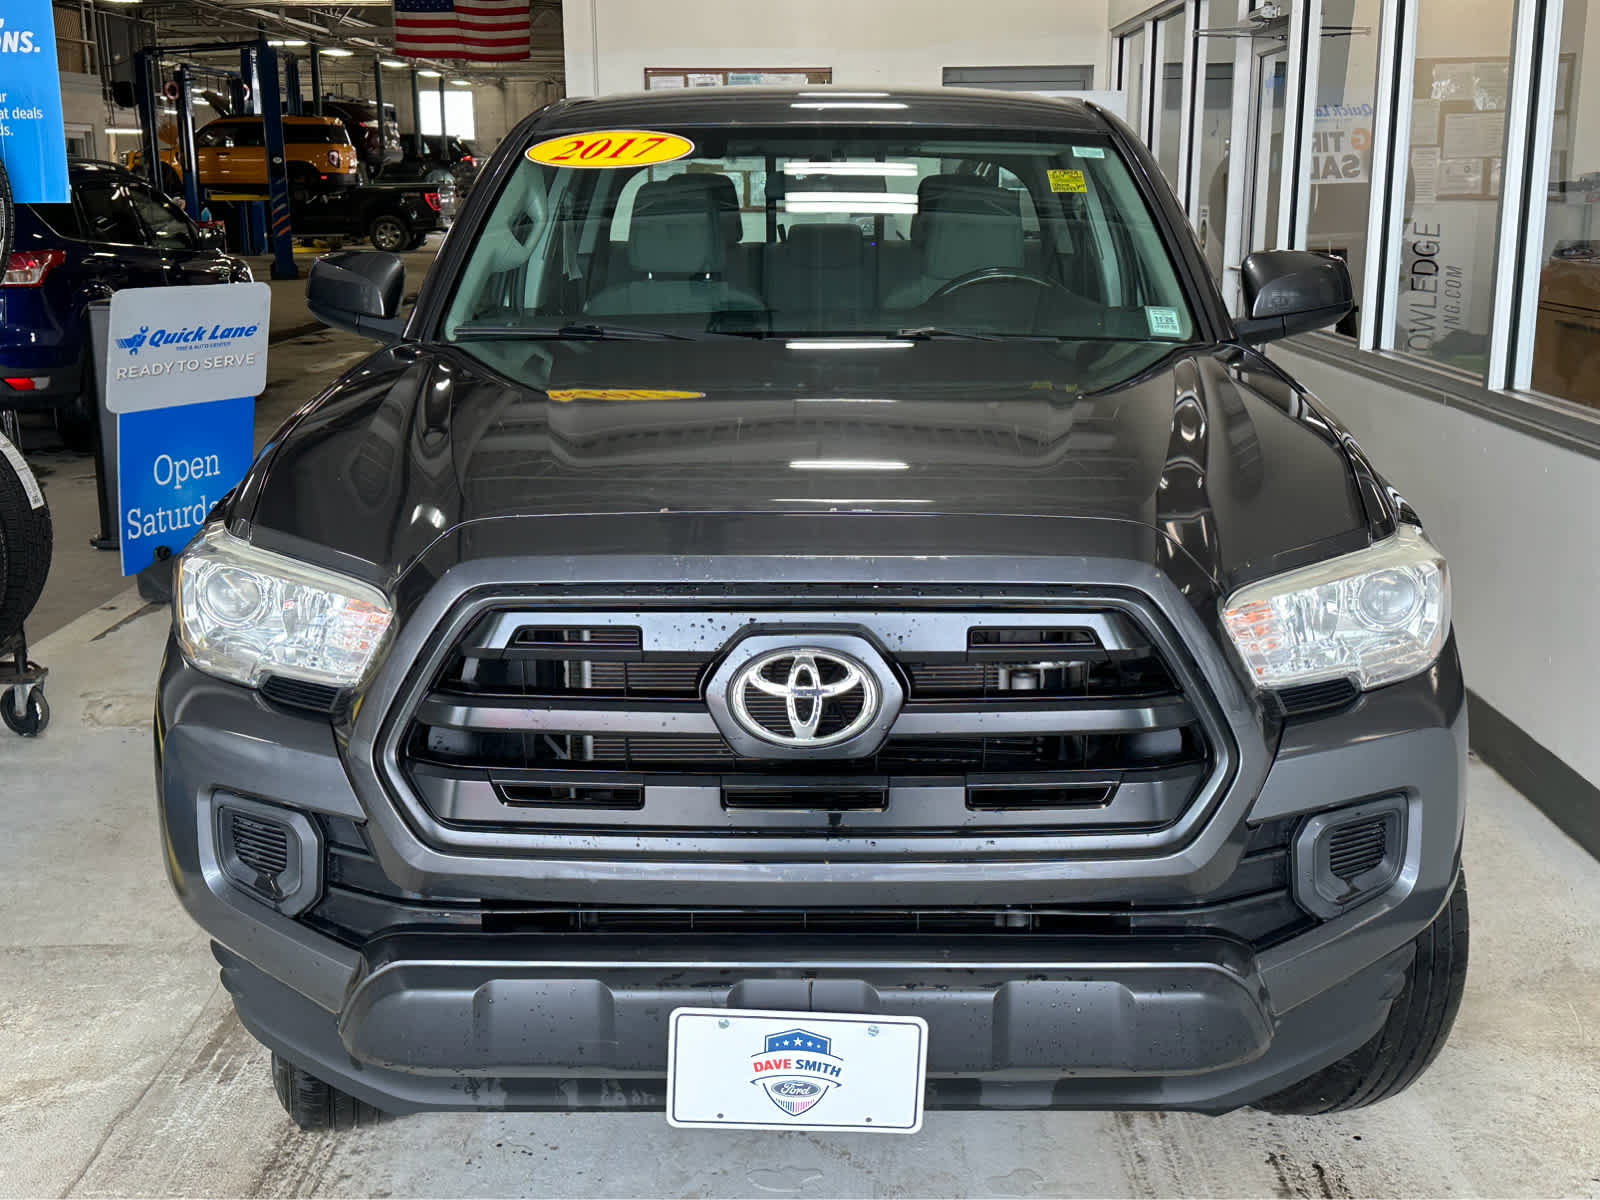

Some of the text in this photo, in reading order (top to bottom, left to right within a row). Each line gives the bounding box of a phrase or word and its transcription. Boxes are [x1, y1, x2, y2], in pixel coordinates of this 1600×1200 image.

[0, 31, 41, 54] NS.
[12, 106, 44, 120] deals
[550, 137, 669, 161] 2017
[149, 324, 258, 348] Quick Lane
[116, 353, 256, 381] READY TO SERVE
[153, 454, 221, 490] Open
[753, 1059, 842, 1078] DAVE SMITH
[781, 1082, 811, 1097] Ford
